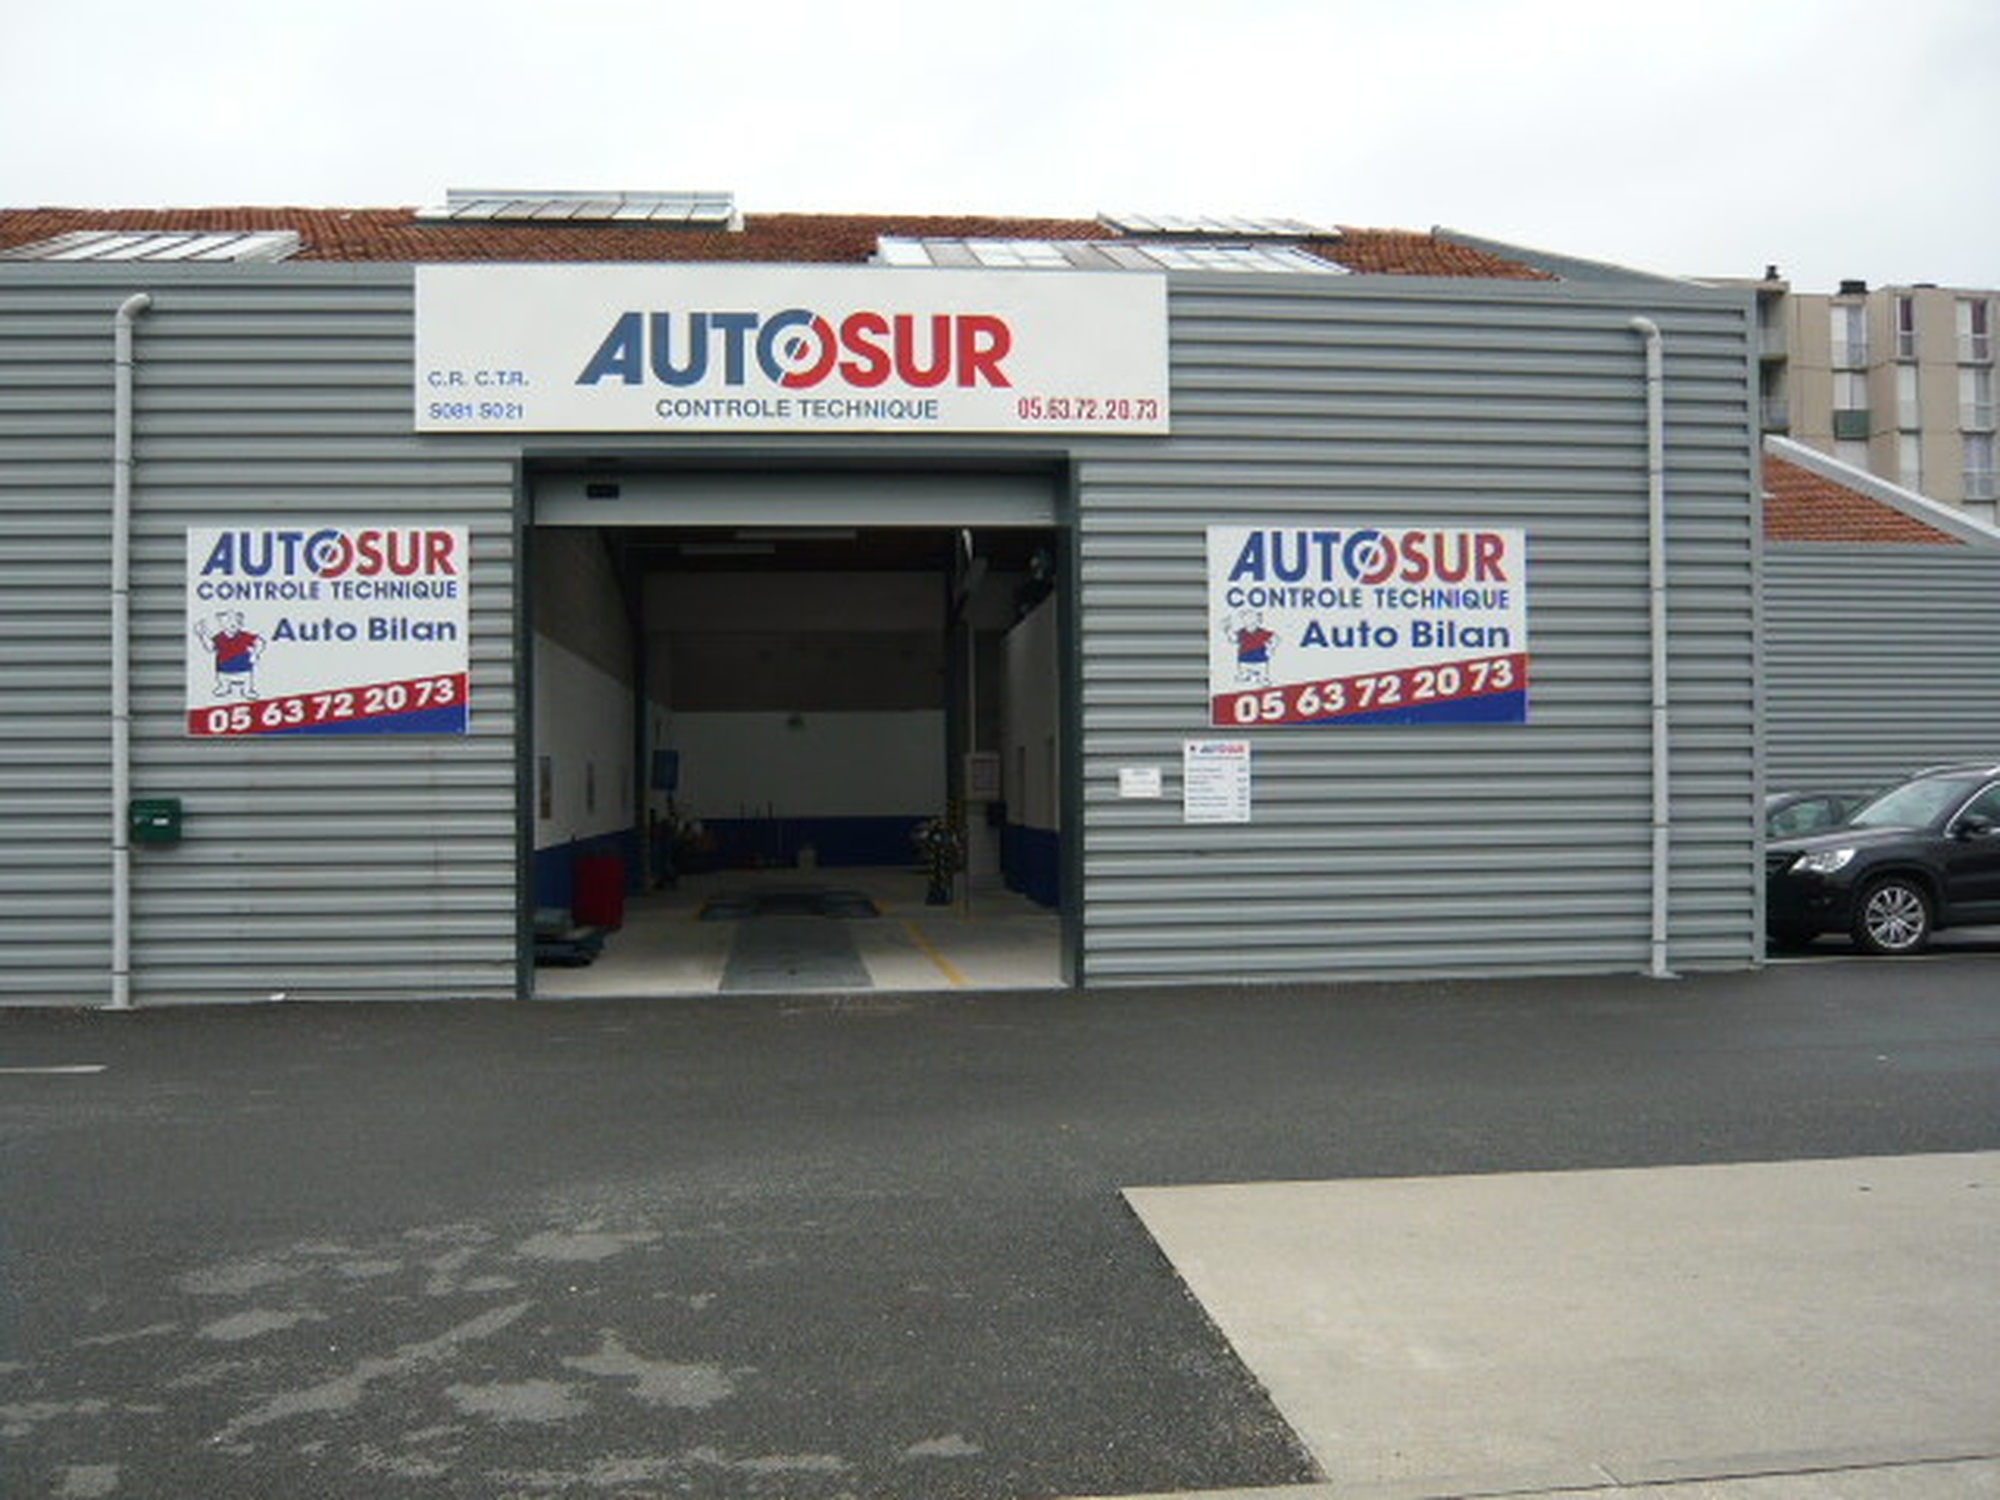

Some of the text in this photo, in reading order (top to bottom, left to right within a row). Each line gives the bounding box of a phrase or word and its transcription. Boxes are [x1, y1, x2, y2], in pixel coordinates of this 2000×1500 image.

[575, 309, 1012, 389] AUTOSUR
[655, 399, 938, 419] CONTROLE TECHNIQUE
[200, 529, 457, 578] AUTOSUR
[1228, 529, 1507, 585] AUTOSUR
[197, 580, 457, 600] CONTROLE TECHNIQUE
[1226, 587, 1509, 610] CONTROLE TECHNIQUE
[271, 617, 456, 642] Auto Bilan
[1299, 620, 1510, 648] Auto Bilan
[208, 678, 455, 733] 05 63 72 20 73
[1233, 659, 1514, 723] 05 63 72 20 73
